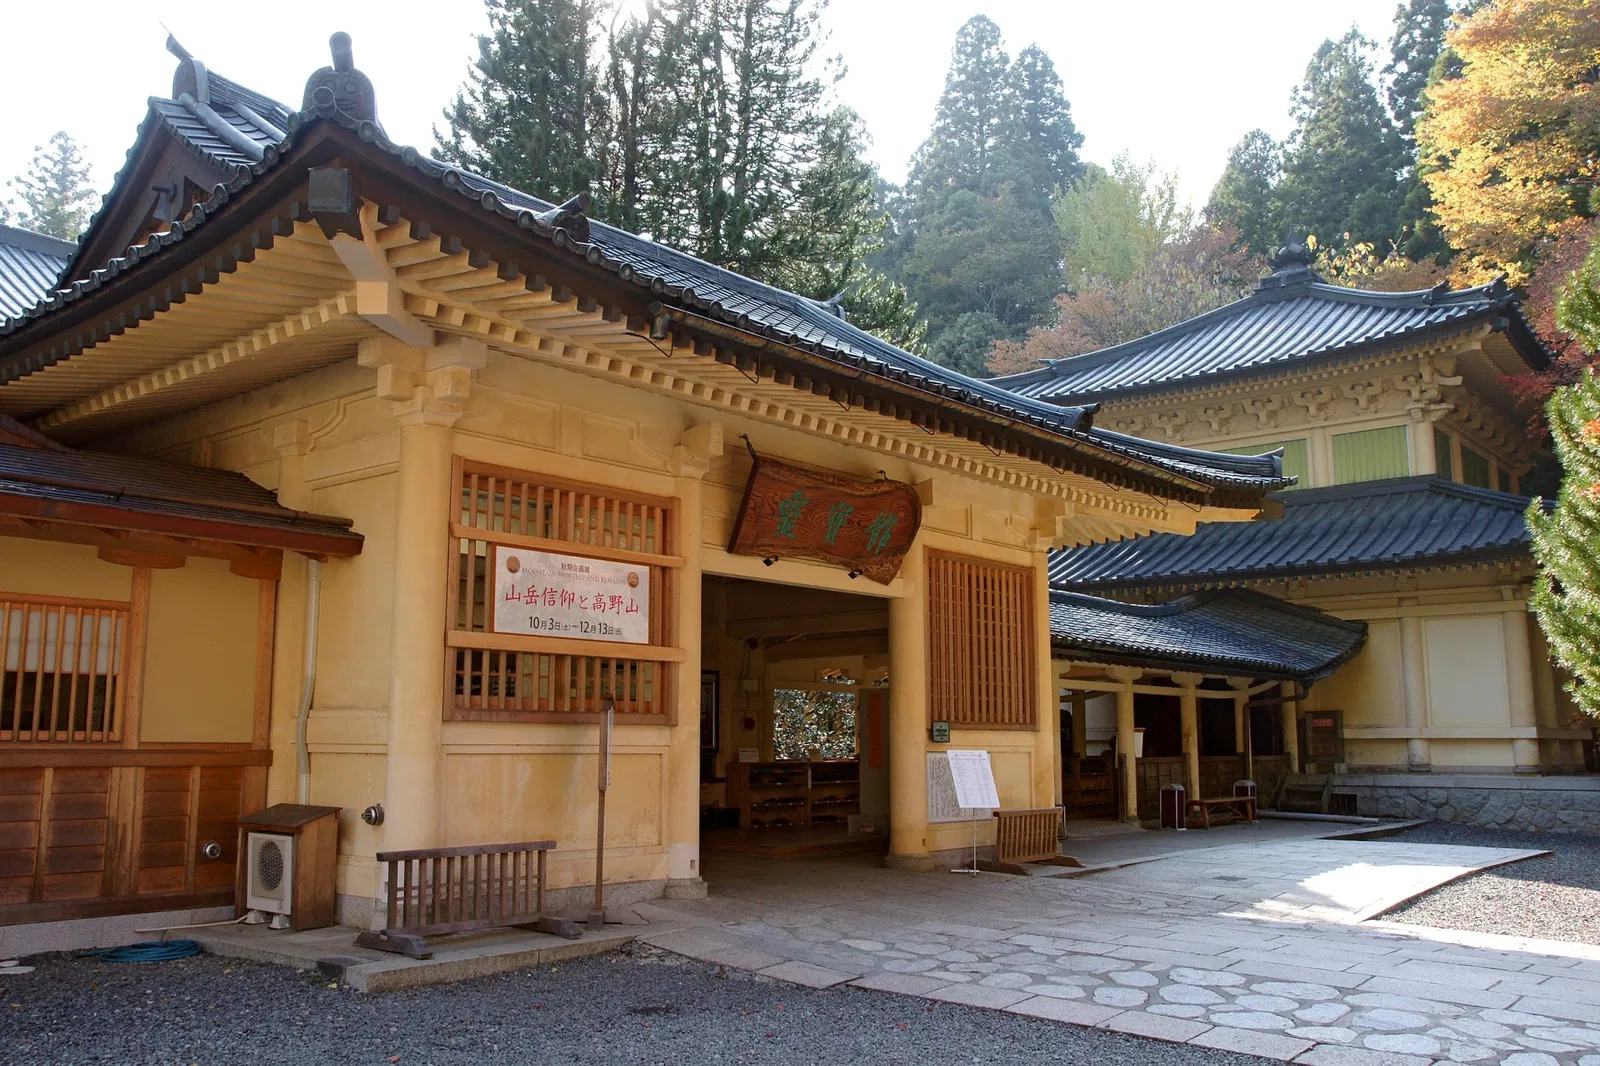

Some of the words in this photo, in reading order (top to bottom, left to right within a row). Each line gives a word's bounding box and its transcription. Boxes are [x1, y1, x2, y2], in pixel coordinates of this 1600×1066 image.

[522, 567, 556, 577] MOUNTAIN
[505, 584, 639, 616] 山岳信仰と高野山
